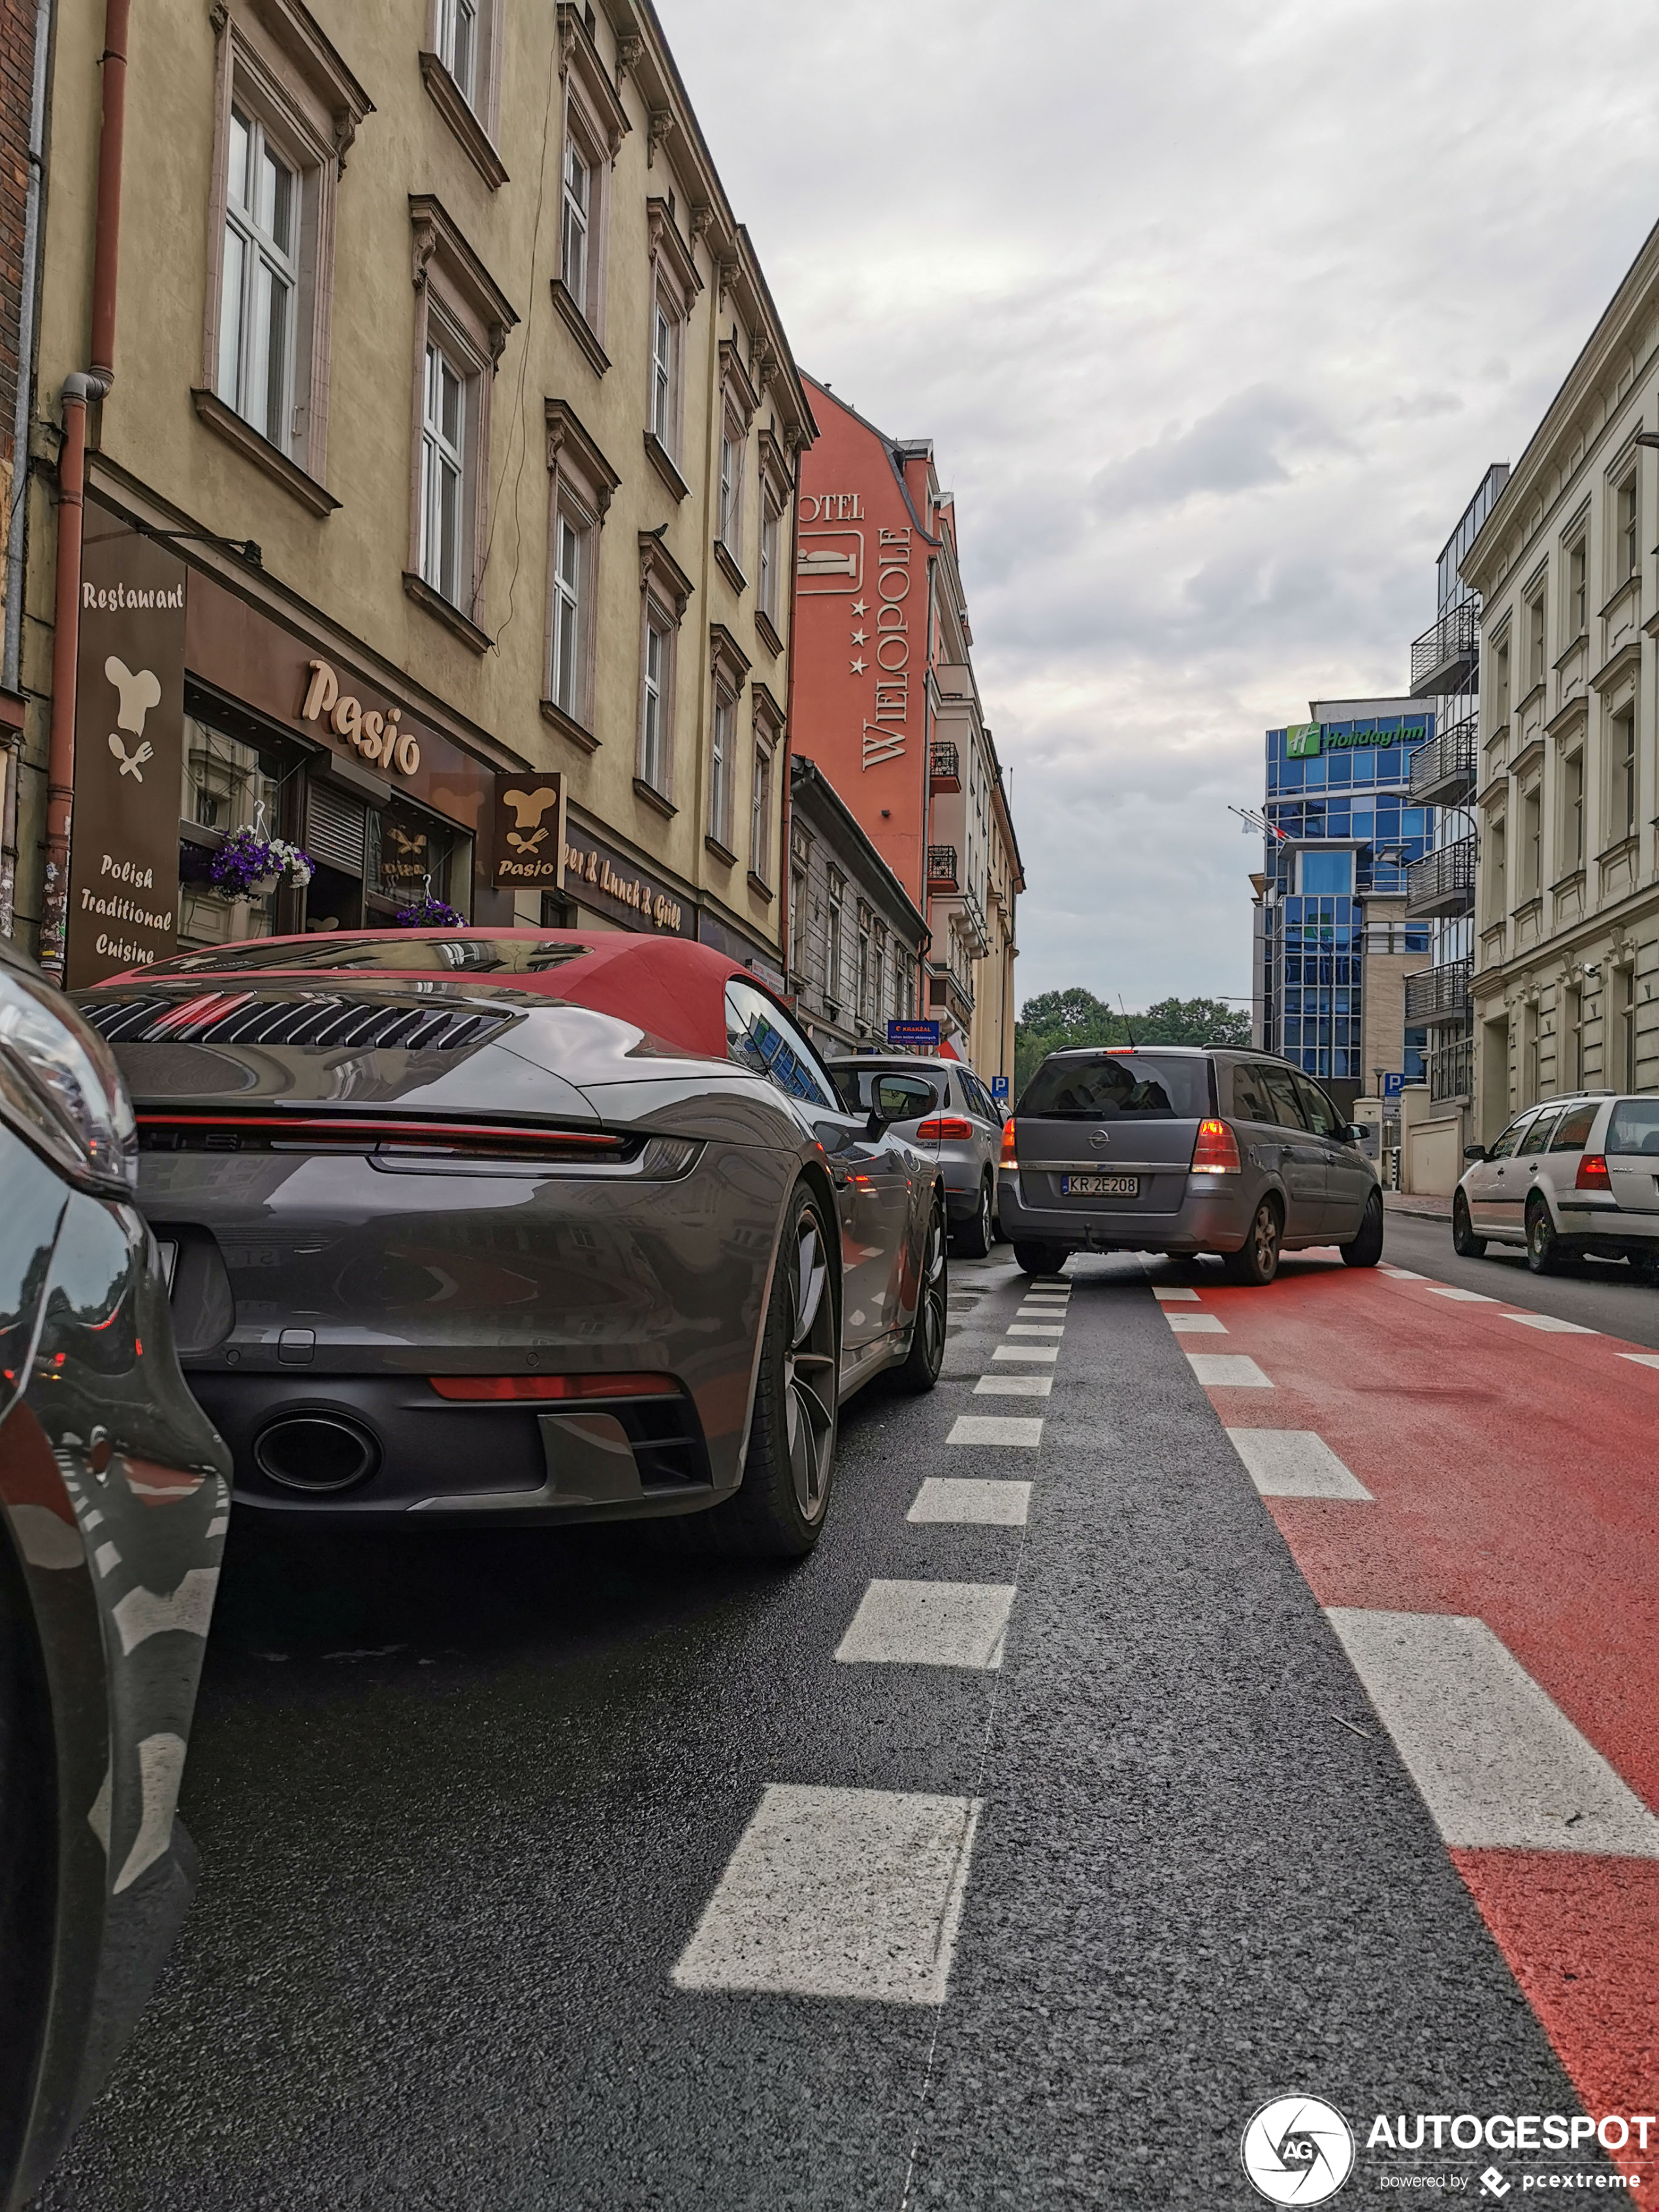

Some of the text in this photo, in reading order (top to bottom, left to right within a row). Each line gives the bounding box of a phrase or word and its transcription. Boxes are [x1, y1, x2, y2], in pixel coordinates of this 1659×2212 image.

[799, 493, 865, 522] OTEL
[83, 583, 184, 612] Restaurant
[863, 526, 913, 772] WIELOPOLE
[1325, 724, 1425, 749] Holiday Inn
[101, 854, 153, 890] Polish
[585, 851, 598, 882] &
[600, 859, 639, 908] Lunch
[641, 886, 652, 915] &
[654, 894, 681, 931] Grill
[82, 890, 172, 932] Traditional
[95, 933, 155, 965] Cuisine
[996, 1078, 1006, 1091] P
[1389, 1075, 1401, 1090] P
[1071, 1178, 1135, 1192] KR 2E208
